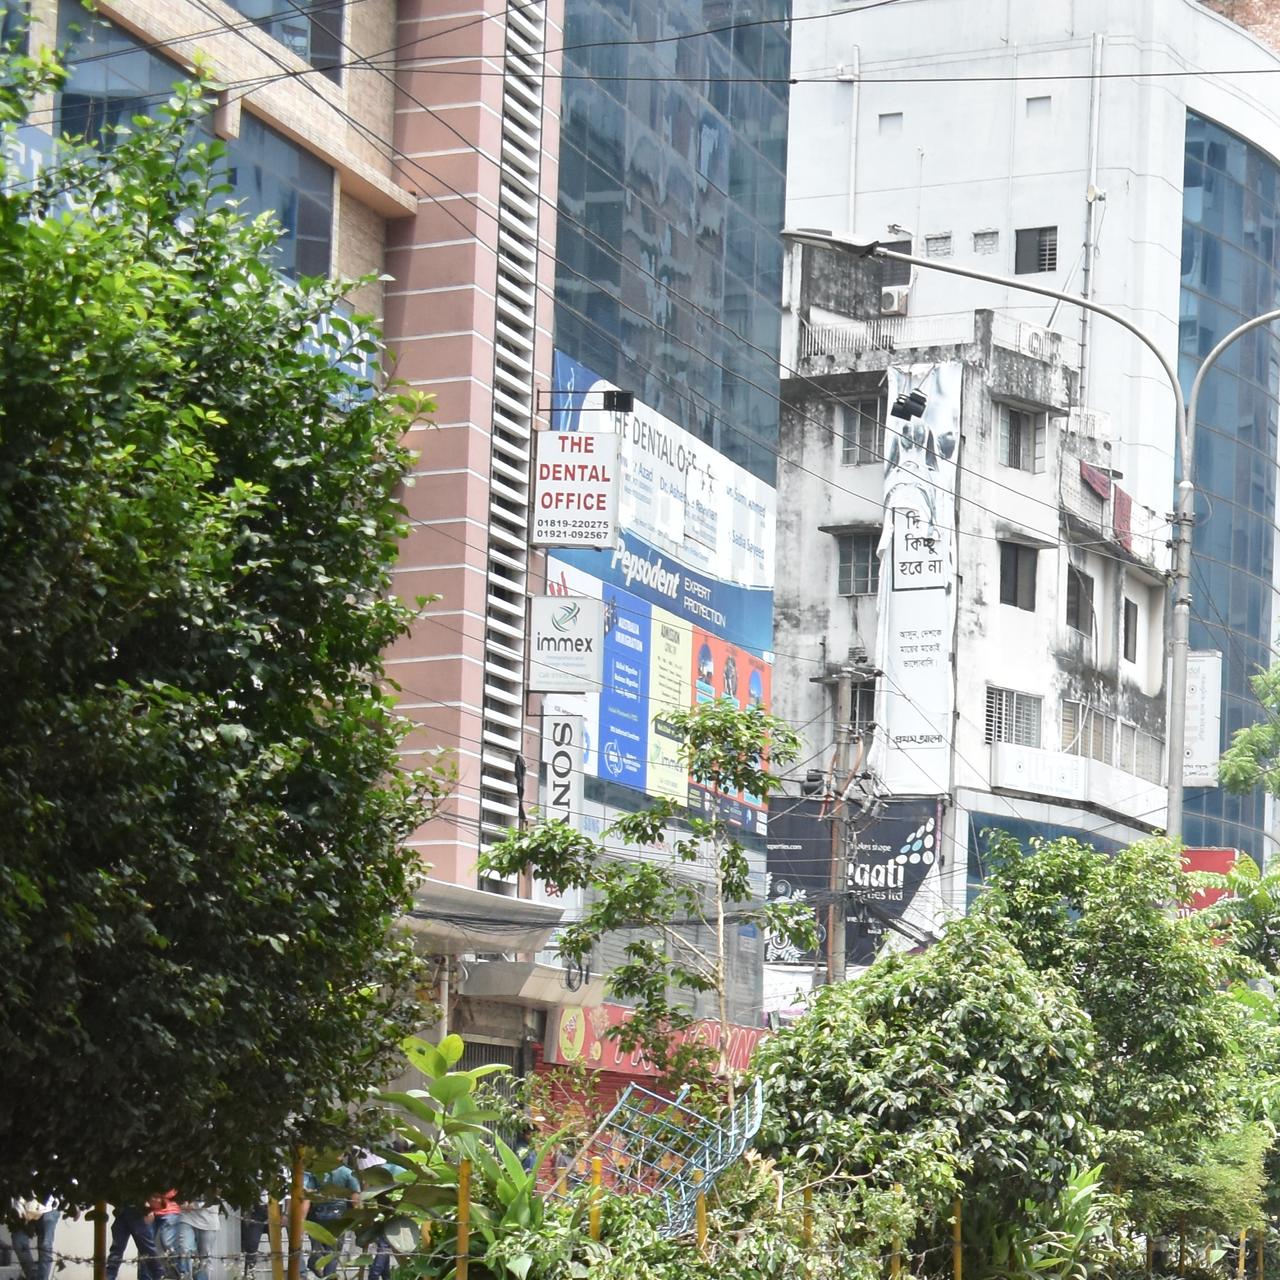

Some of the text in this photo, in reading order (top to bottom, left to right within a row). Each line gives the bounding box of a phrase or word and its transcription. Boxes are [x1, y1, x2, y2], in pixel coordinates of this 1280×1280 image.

[559, 436, 594, 453] THE
[633, 417, 674, 467] DENTAL
[539, 464, 610, 482] DENTAL
[541, 492, 607, 511] OFFICE
[537, 519, 609, 530] 01819-220275
[537, 530, 609, 540] 01921-092567
[612, 537, 680, 600] Pepsodent
[899, 559, 943, 575] হবে না
[684, 577, 712, 602] EXPERT
[683, 597, 726, 628] PROTECTION
[537, 632, 593, 653] immex
